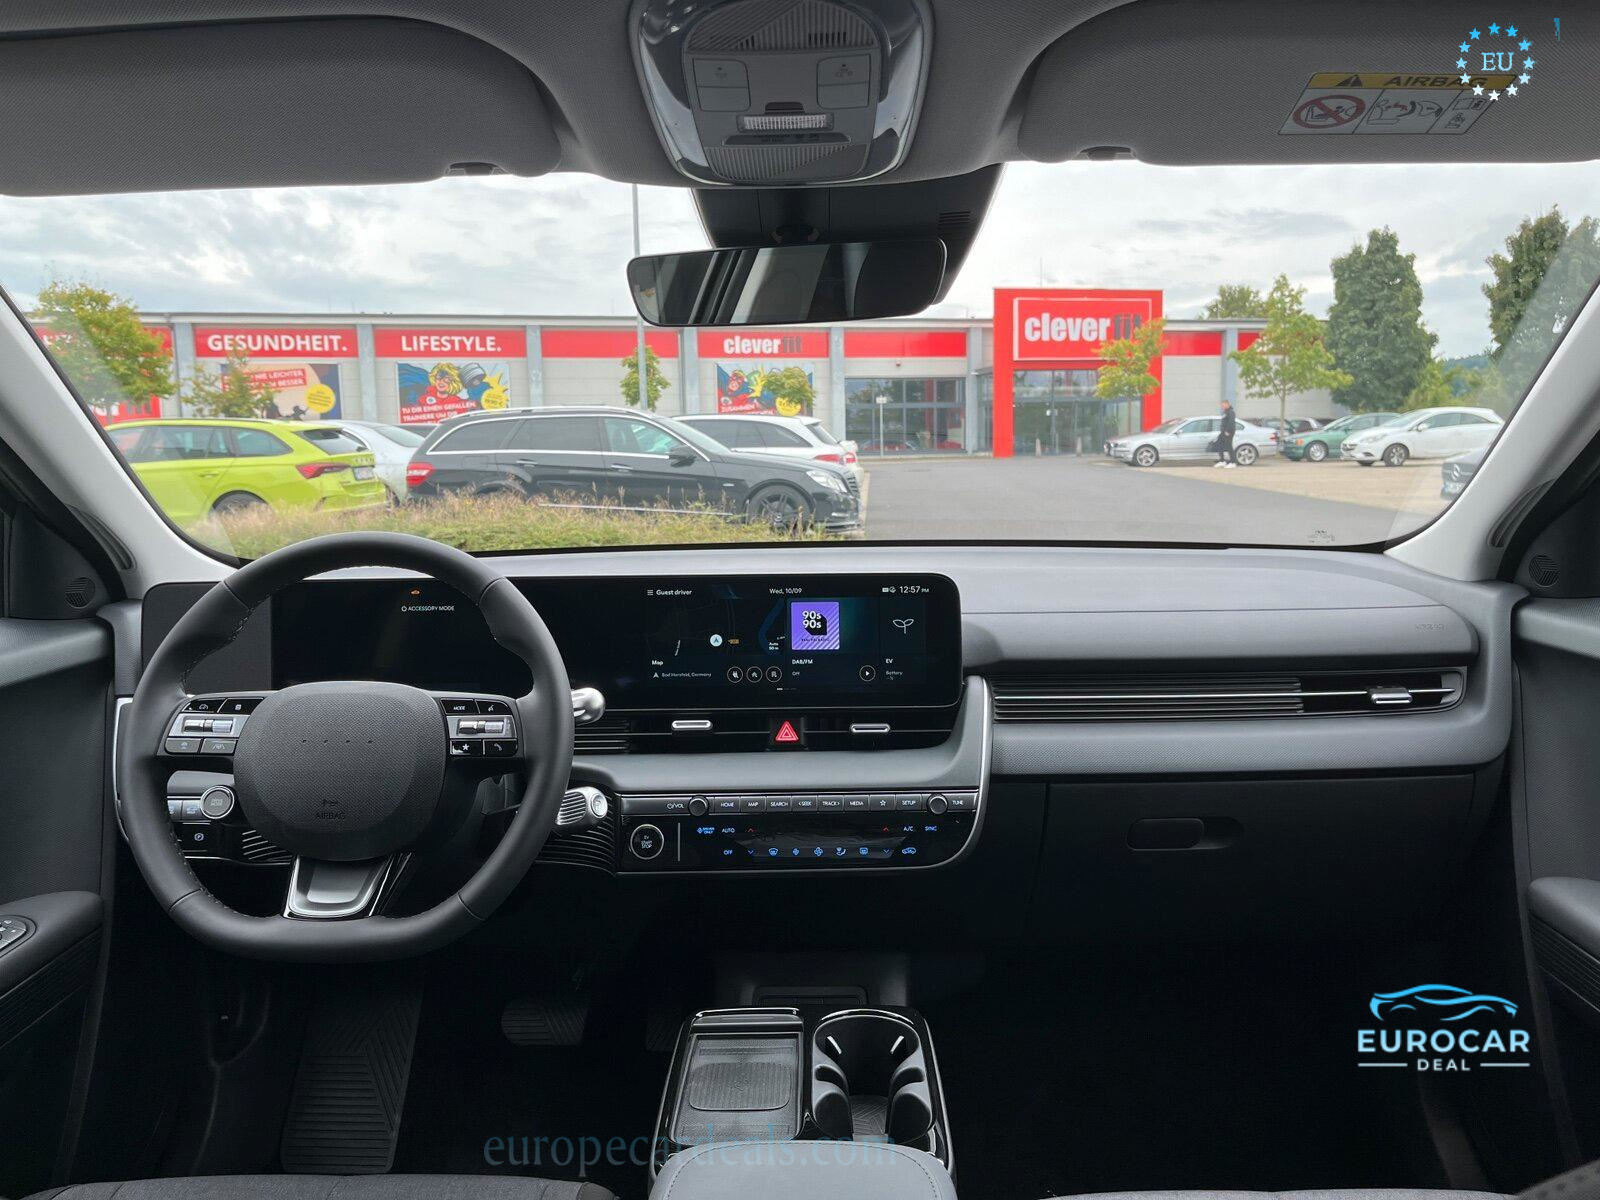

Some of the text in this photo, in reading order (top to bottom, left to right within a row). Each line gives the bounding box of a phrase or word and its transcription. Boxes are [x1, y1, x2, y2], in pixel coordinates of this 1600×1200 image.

[1383, 76, 1488, 87] AIRBAG
[1024, 312, 1111, 342] clever
[207, 334, 348, 352] GESUNDHEIT.
[401, 335, 502, 352] LIFESTYLE.
[723, 335, 781, 354] clever
[674, 588, 692, 596] driver
[769, 587, 803, 596] Wed, 10/09
[899, 585, 921, 594] 12:57
[802, 610, 822, 620] 90s
[802, 619, 822, 629] 90s
[651, 659, 664, 667] Map
[316, 812, 346, 820] AIRBAG
